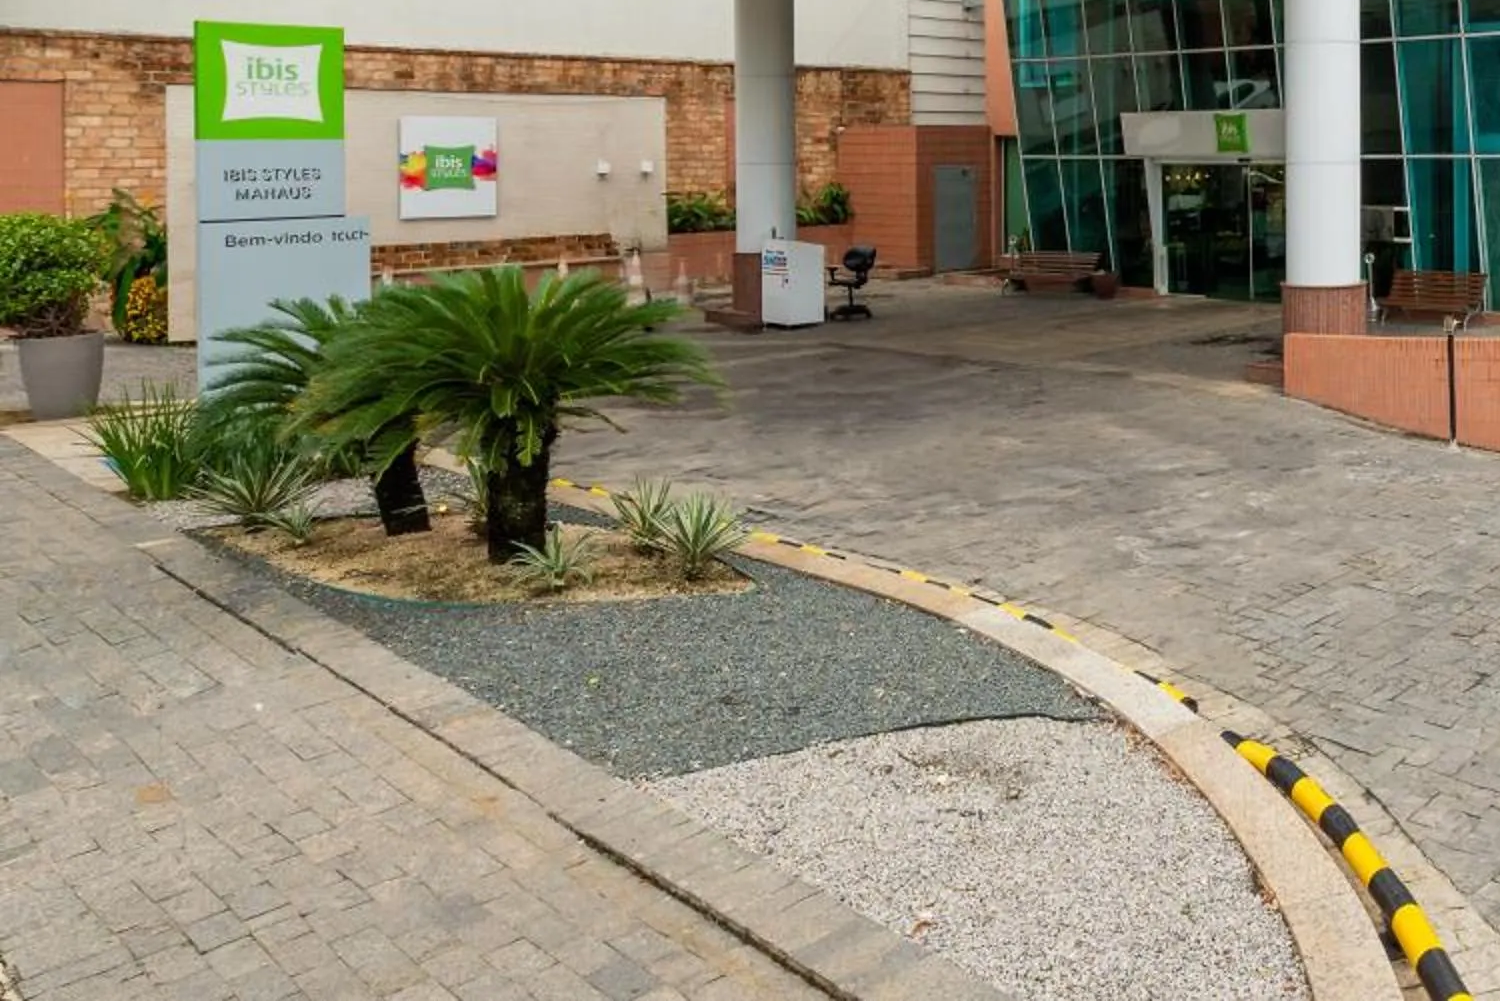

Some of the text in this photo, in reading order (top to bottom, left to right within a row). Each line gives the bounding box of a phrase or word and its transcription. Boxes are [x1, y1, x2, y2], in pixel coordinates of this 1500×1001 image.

[246, 56, 300, 81] ibis
[435, 154, 464, 169] ibis
[262, 167, 321, 182] STYLES
[224, 231, 323, 248] Bem-vindo
